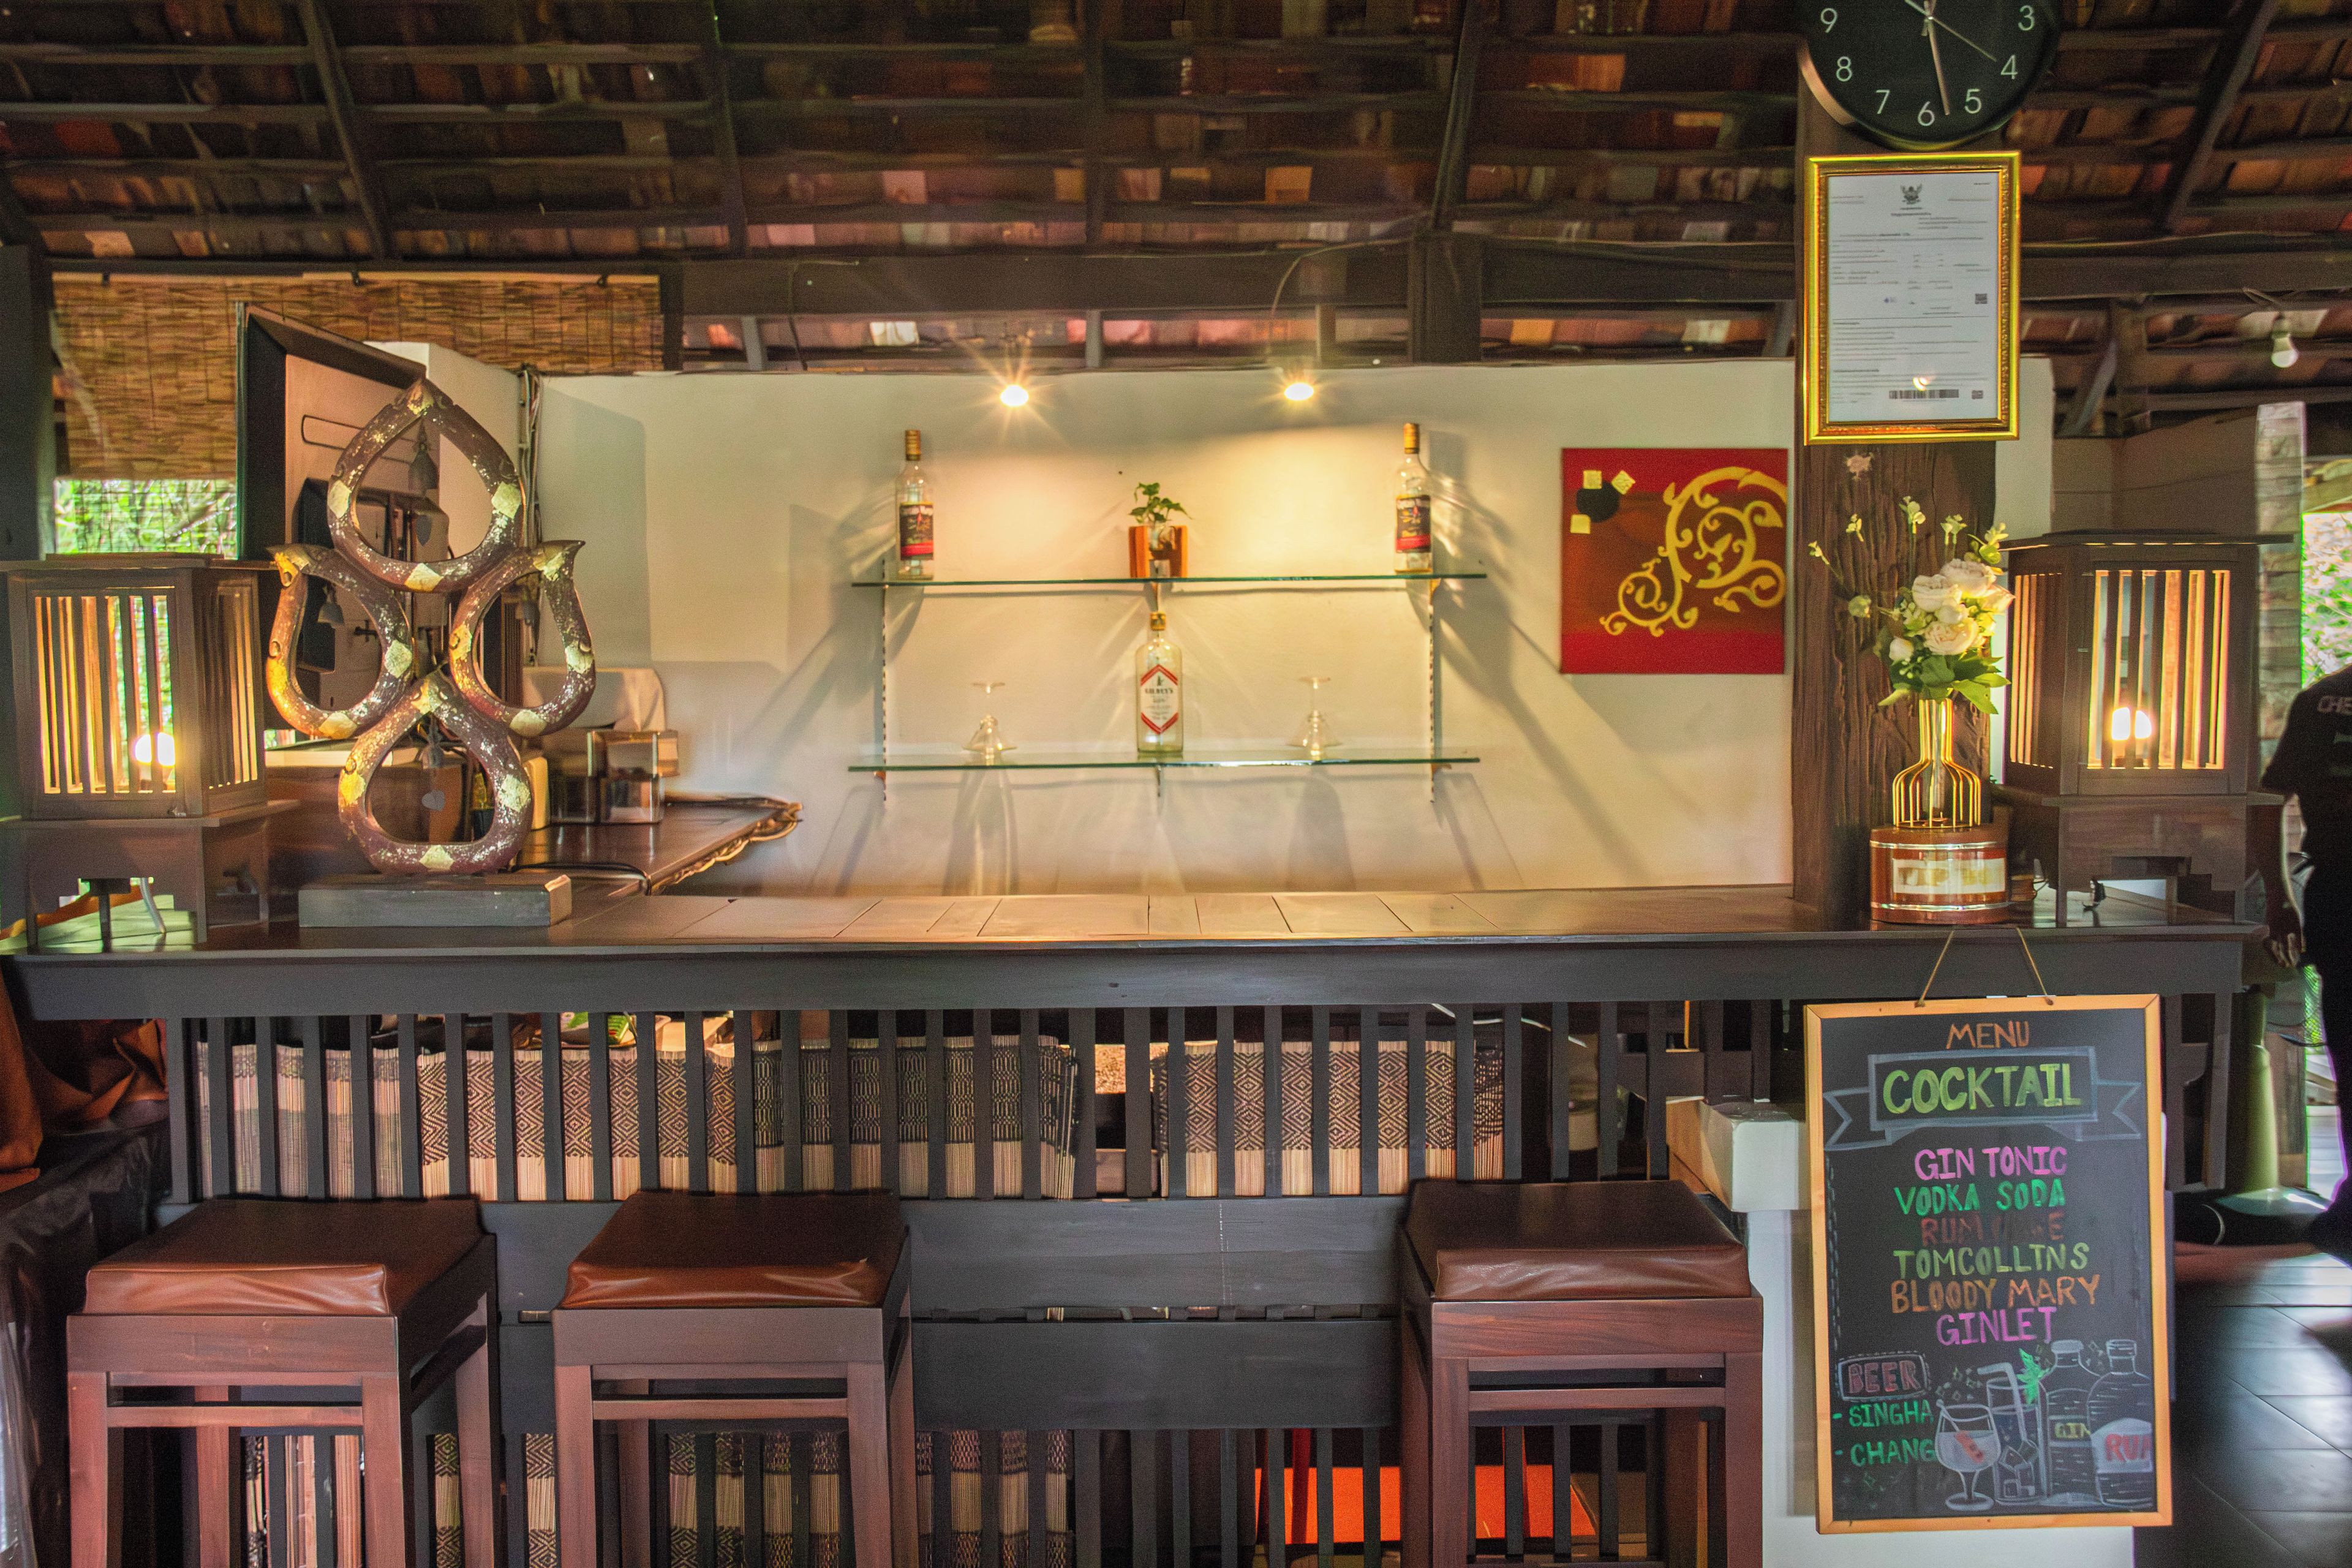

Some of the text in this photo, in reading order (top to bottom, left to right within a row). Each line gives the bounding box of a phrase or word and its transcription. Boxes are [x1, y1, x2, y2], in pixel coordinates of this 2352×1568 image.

[1820, 7, 1838, 34] 9
[2018, 5, 2035, 31] 3
[1836, 56, 1853, 82] 8
[2000, 55, 2018, 80] 4
[1875, 89, 1890, 115] 7
[1917, 100, 1936, 126] 6
[1964, 88, 1982, 114] 5
[1945, 1021, 2030, 1049] MENU
[1883, 1063, 2082, 1114] COCKTAIL
[1914, 1145, 2067, 1180] GIN TONIC
[1893, 1178, 2066, 1216] VODKA SODA
[1890, 1273, 2100, 1313] BLOODY MARY
[1936, 1306, 2057, 1346] GINLET
[1848, 1360, 1921, 1393] BEER
[1849, 1399, 1934, 1427] SINGHA
[1850, 1438, 1937, 1468] CHANG
